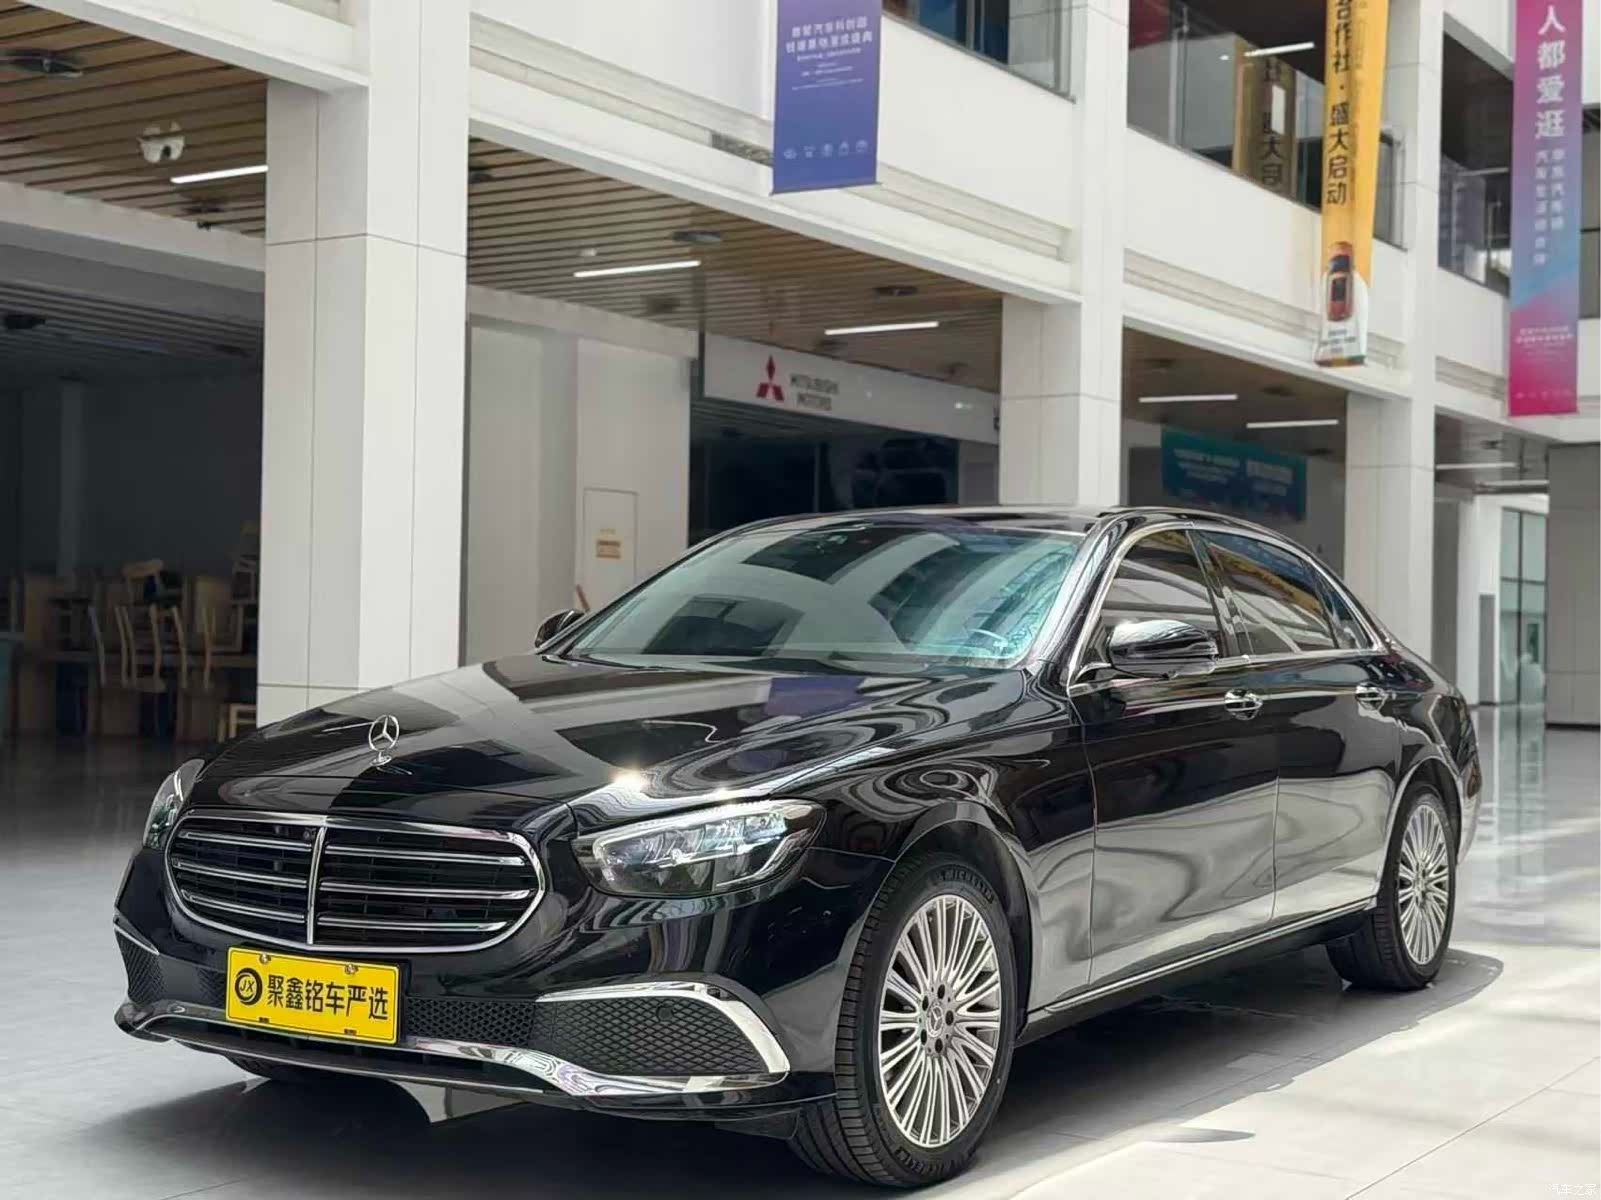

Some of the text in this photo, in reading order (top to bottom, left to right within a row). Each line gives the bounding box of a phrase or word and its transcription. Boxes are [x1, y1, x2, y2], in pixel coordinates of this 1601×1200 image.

[1535, 5, 1566, 139] 人都爱逛
[267, 974, 388, 1020] 聚鑫铭车严选
